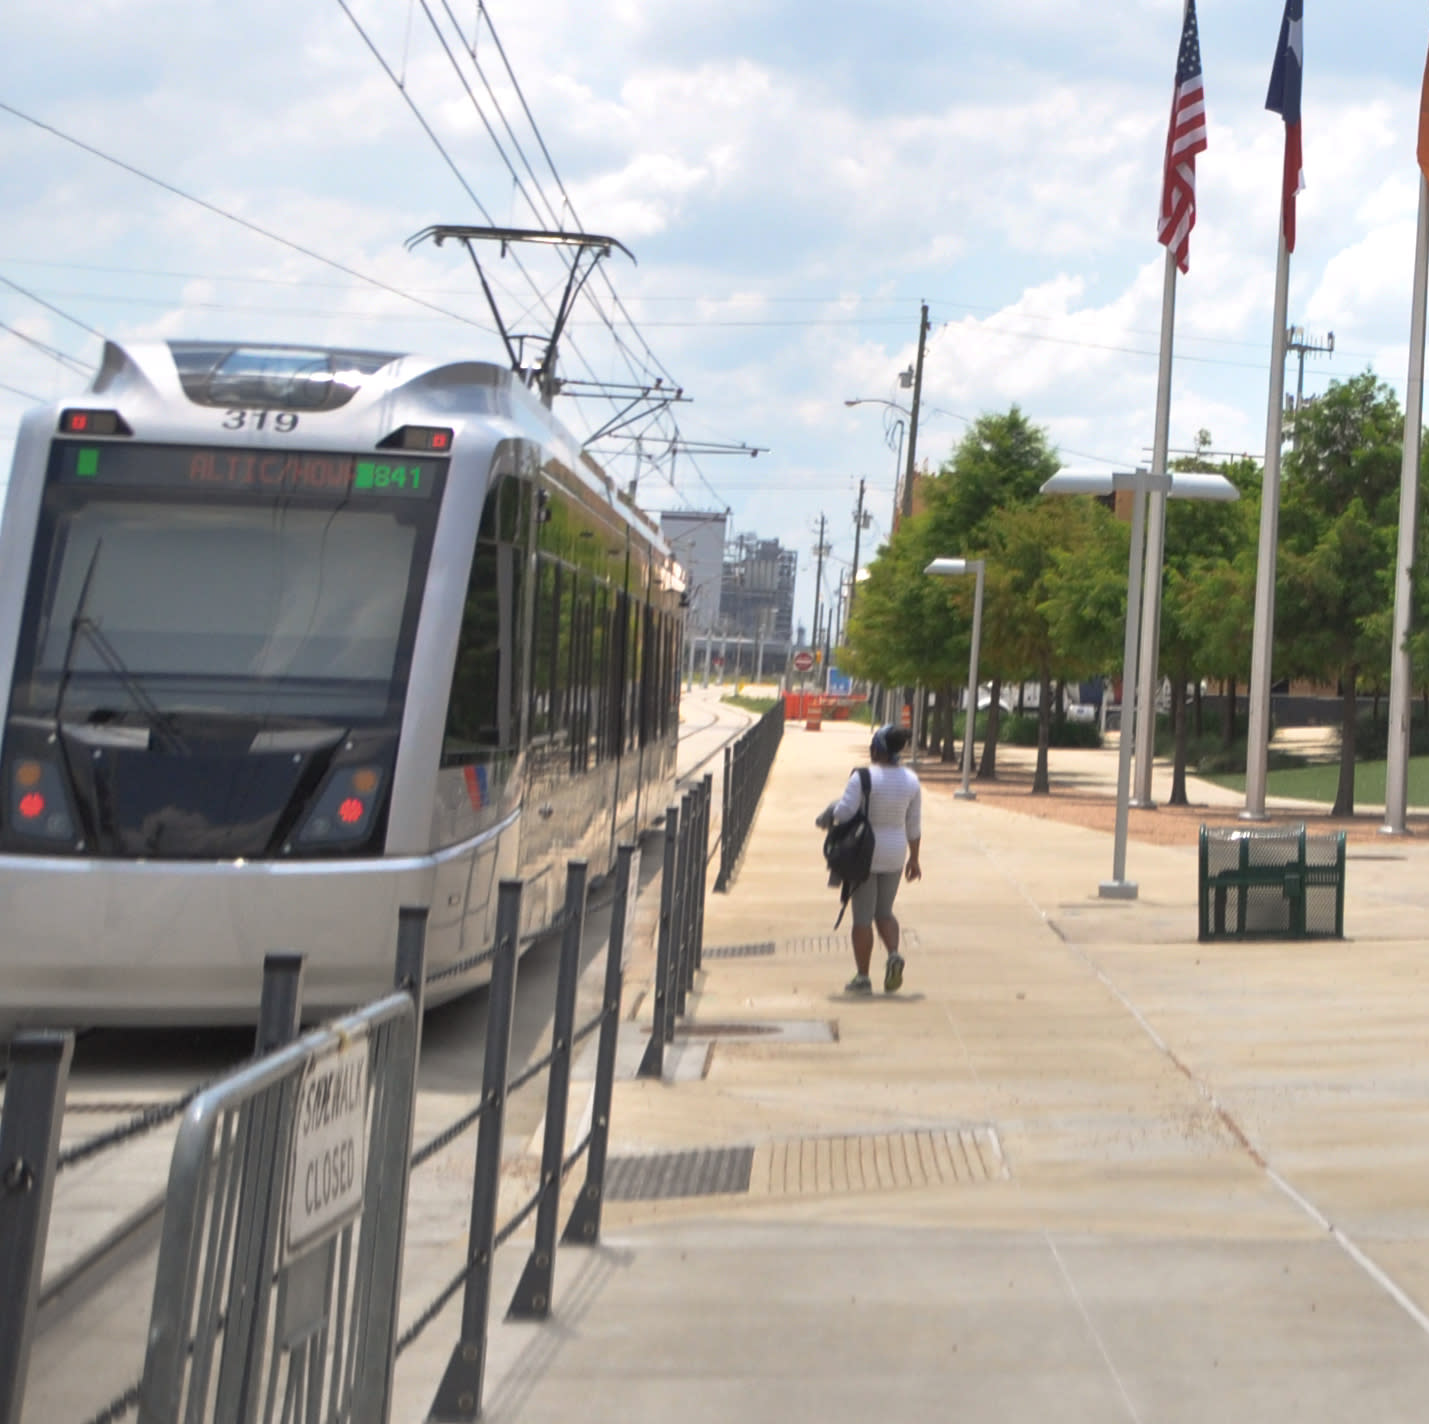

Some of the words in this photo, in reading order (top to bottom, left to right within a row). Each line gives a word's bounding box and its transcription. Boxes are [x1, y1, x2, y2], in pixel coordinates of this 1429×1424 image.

[222, 409, 299, 432] 319
[373, 463, 421, 489] 841
[303, 1057, 364, 1136] SIDEWALK
[305, 1139, 354, 1216] CLOSED
